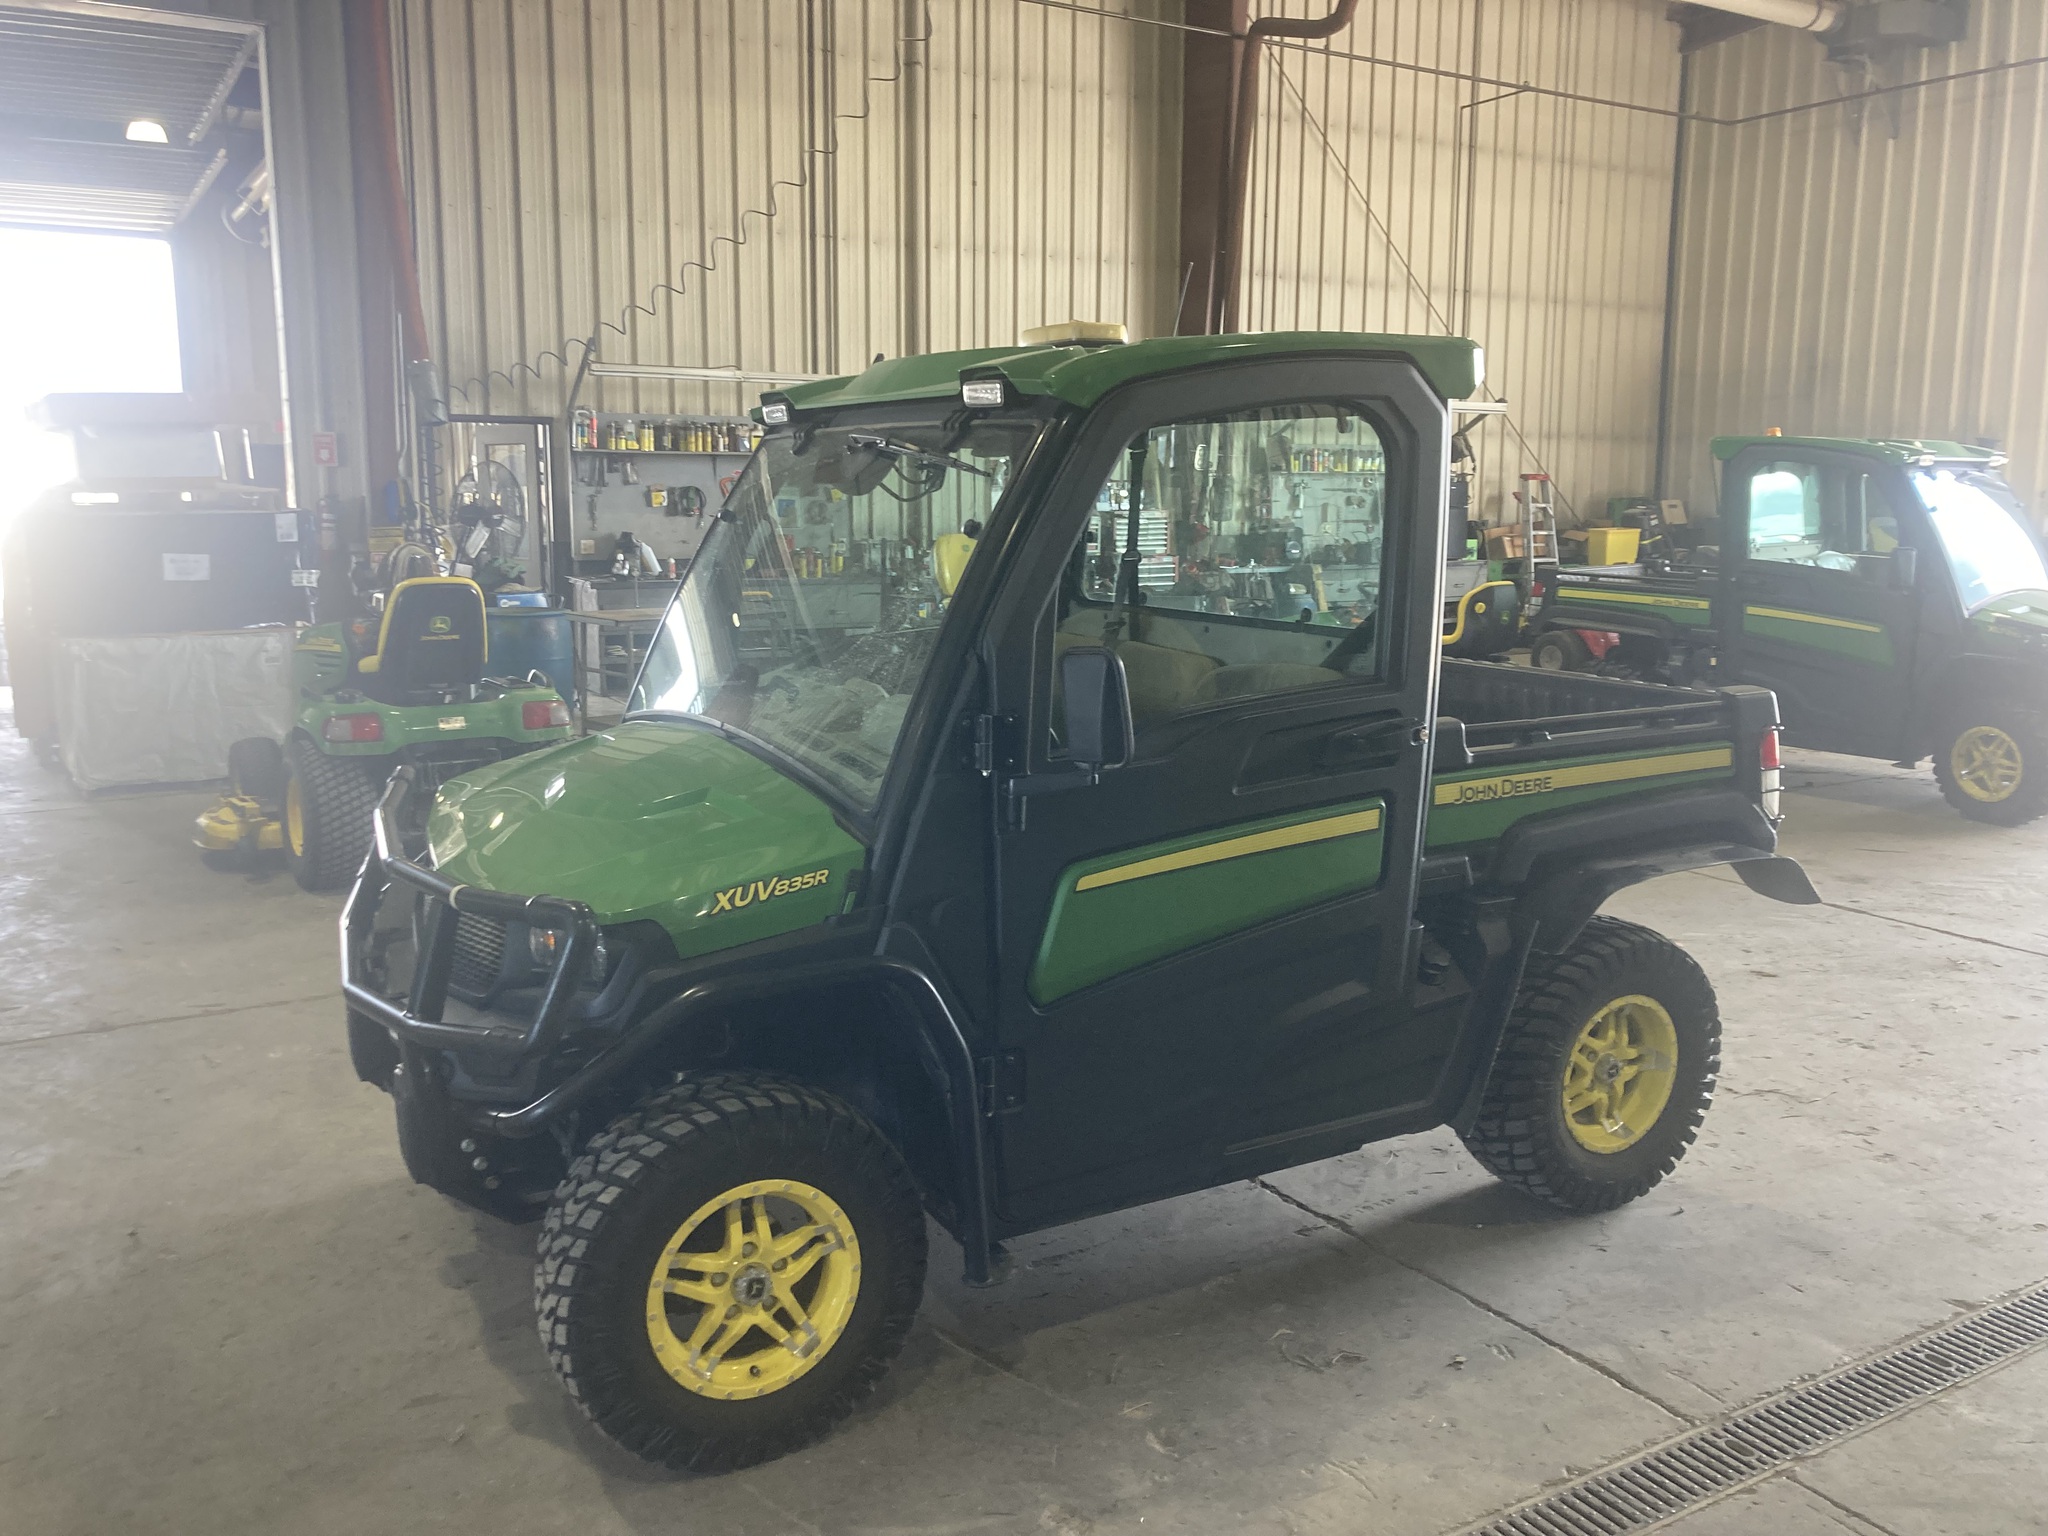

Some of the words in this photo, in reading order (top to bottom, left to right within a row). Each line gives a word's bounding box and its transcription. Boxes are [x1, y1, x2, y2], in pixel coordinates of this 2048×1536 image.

[1454, 784, 1498, 803] JOHN
[1501, 776, 1553, 797] DEERE
[710, 868, 830, 915] XUV835R
